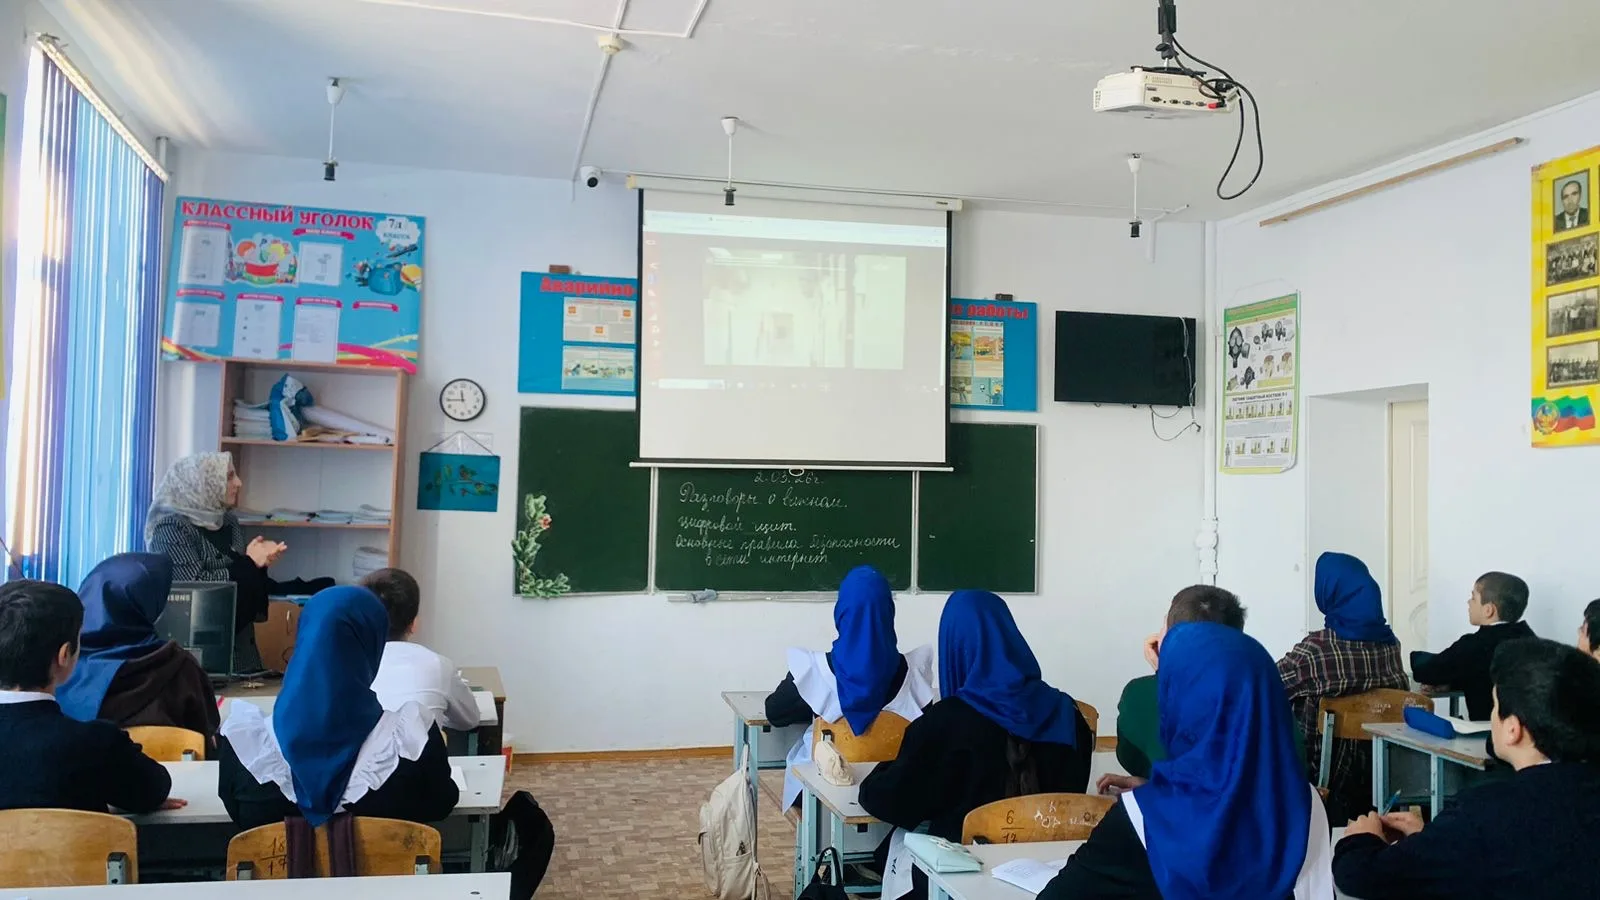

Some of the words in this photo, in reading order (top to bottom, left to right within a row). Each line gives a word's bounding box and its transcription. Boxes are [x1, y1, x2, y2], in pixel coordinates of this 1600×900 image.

[182, 201, 294, 224] КЛАССНЫЙ
[299, 212, 374, 231] УГОЛОК
[967, 304, 1029, 320] работы
[167, 593, 191, 602] SUNG
[1006, 810, 1015, 825] 6
